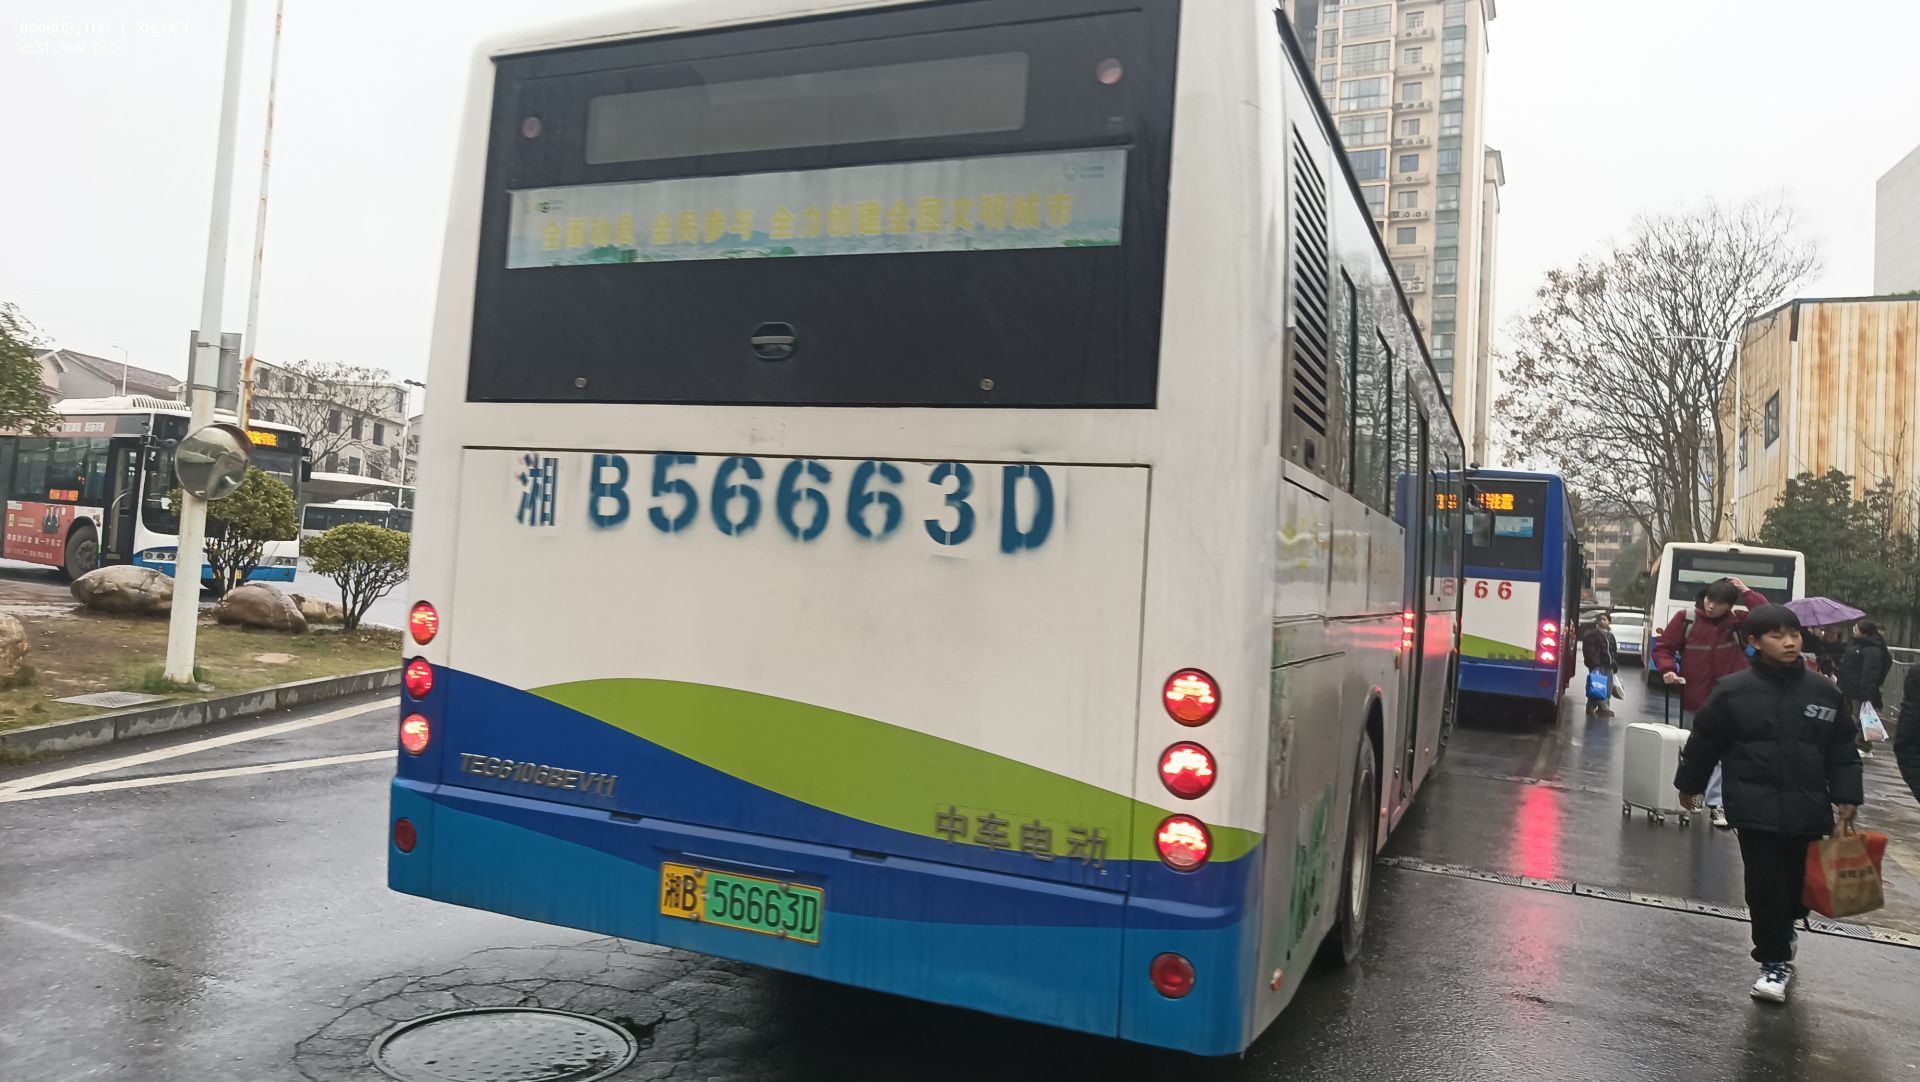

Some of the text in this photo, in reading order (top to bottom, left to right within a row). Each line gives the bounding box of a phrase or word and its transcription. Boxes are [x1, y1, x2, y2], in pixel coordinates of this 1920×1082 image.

[460, 752, 618, 797] TEG6106BEV11
[934, 804, 1107, 869] 中车电动
